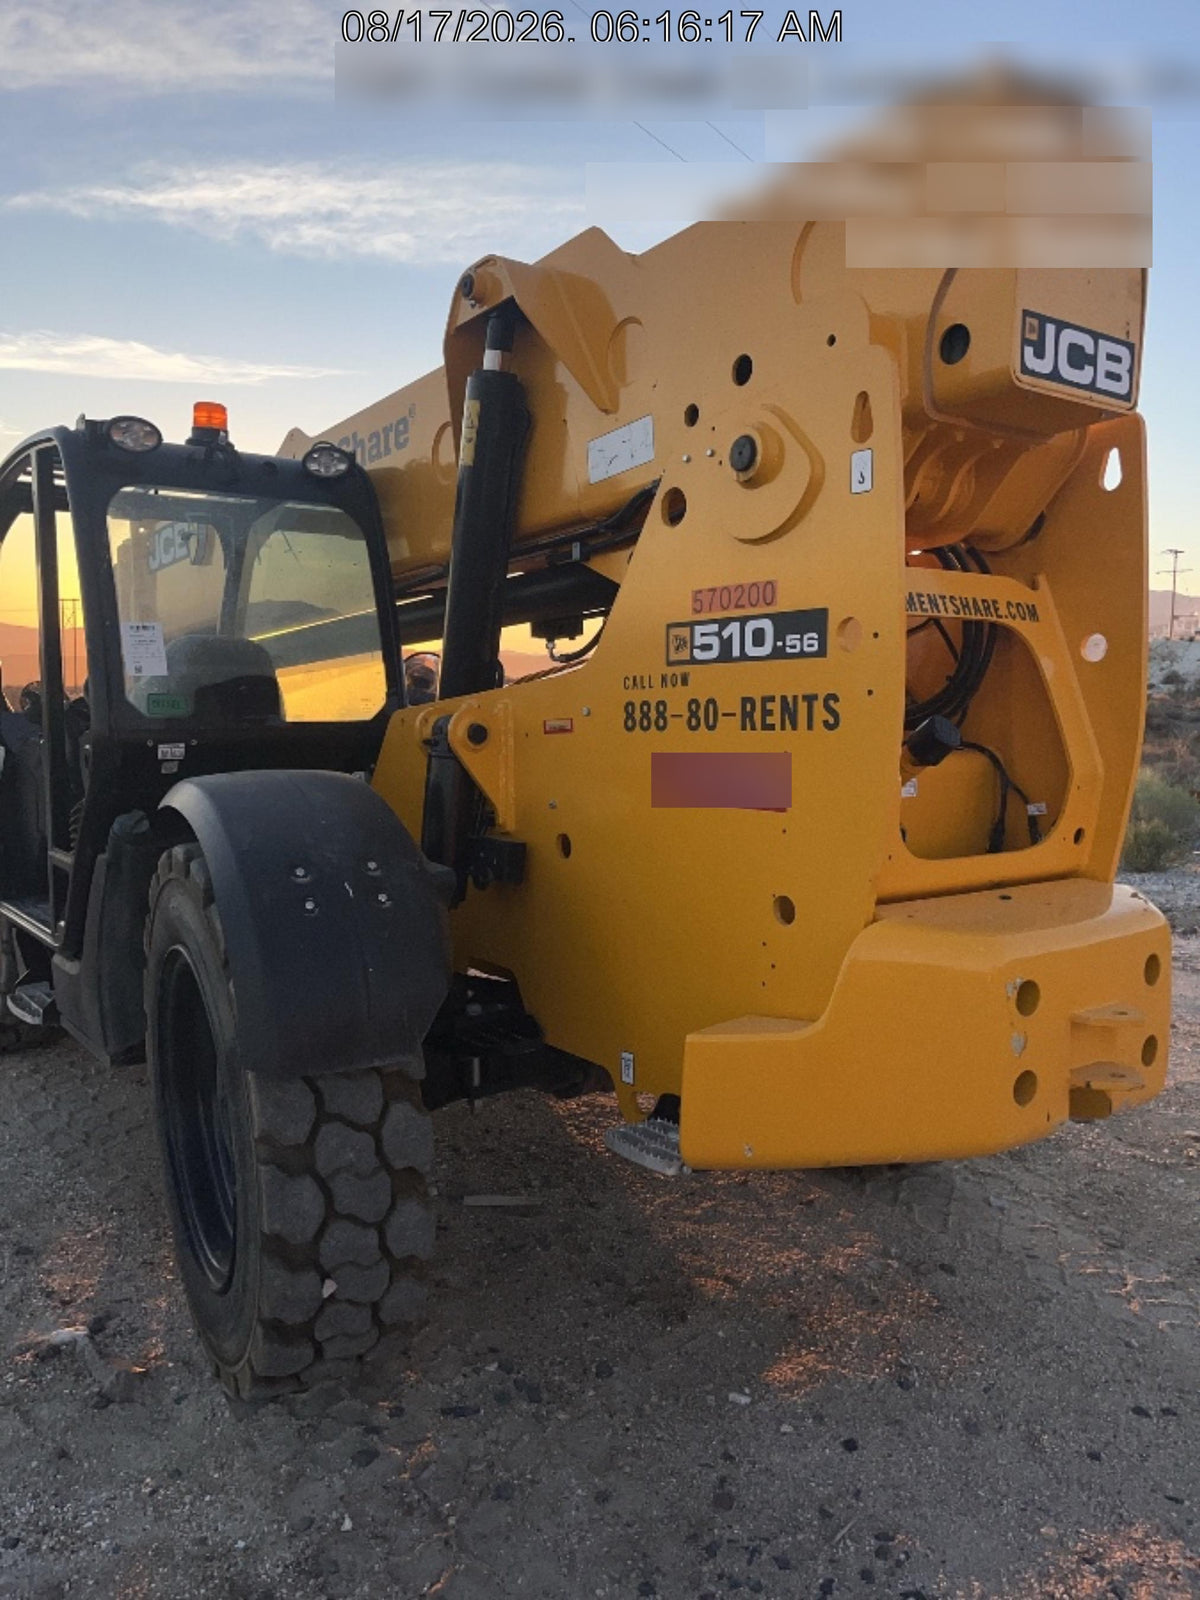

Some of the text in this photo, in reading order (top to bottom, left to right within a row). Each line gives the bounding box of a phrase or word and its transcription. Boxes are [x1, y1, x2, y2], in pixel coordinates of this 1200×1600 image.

[1023, 322, 1132, 396] JCB
[692, 580, 777, 614] 570200
[905, 591, 1039, 622] MENTSHARE.COM
[623, 671, 691, 690] CALL NOW
[623, 692, 842, 733] 888-80-RENTS
